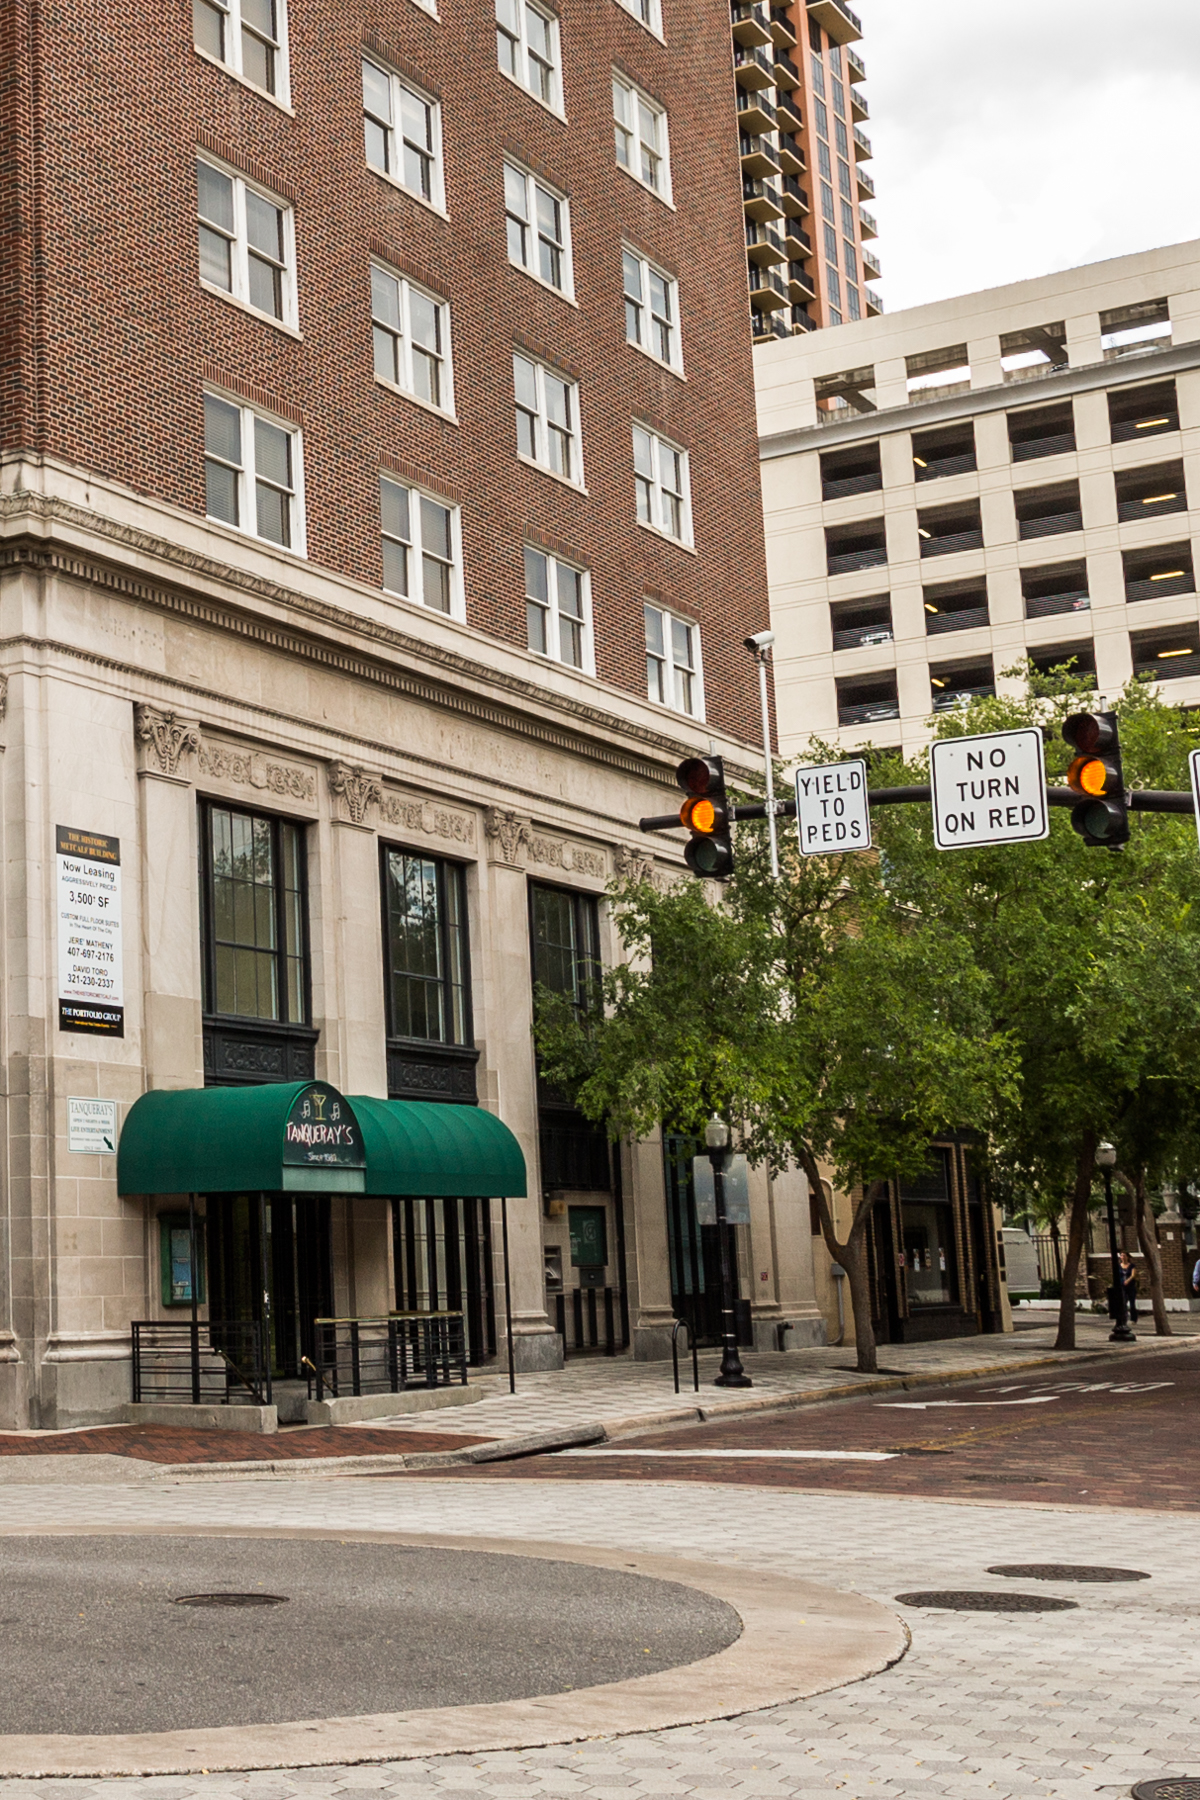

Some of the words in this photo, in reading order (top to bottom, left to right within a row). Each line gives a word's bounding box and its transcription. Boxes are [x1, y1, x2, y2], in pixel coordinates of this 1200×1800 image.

[967, 748, 1006, 771] NO
[801, 771, 861, 796] YIELD
[956, 776, 1020, 801] TURN
[820, 797, 844, 818] TO
[945, 811, 975, 833] ON
[989, 805, 1035, 828] RED
[68, 832, 79, 841] THE
[81, 834, 109, 847] HISTORIC
[807, 820, 861, 844] PEDS
[89, 848, 117, 860] BUILDING
[63, 860, 81, 872] Now
[84, 865, 114, 882] Leasing
[98, 896, 109, 908] SF
[86, 940, 113, 950] MATHENY
[67, 947, 114, 962] 407-697-2176
[73, 965, 90, 974] DAVID
[92, 967, 108, 976] TORO
[68, 974, 114, 988] 321-230-2337
[62, 1007, 72, 1016] THE
[73, 1008, 102, 1020] PORTFOLIO
[103, 1012, 121, 1022] GROUP
[286, 1121, 353, 1147] TANQUERAY'S
